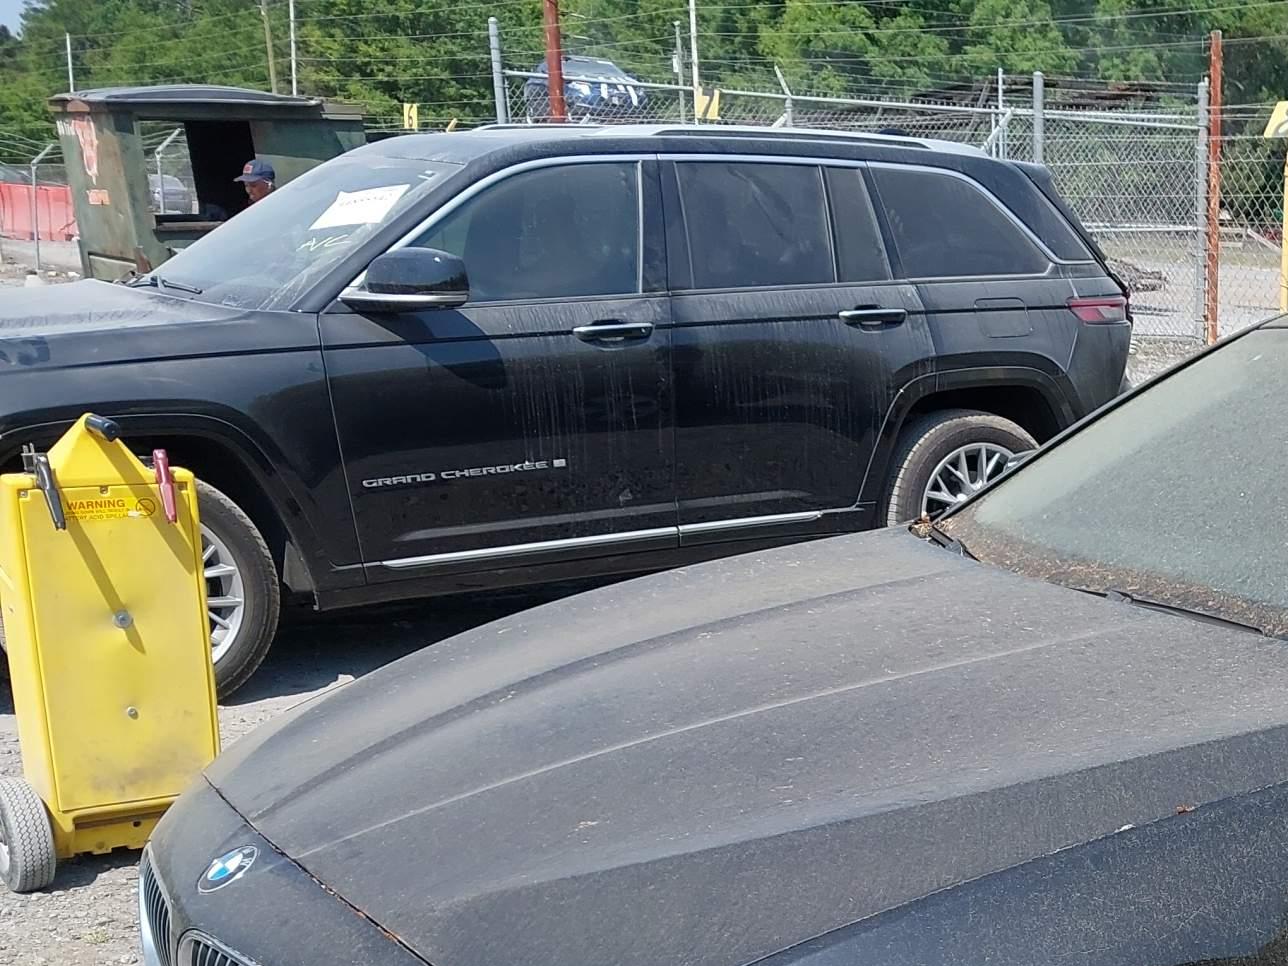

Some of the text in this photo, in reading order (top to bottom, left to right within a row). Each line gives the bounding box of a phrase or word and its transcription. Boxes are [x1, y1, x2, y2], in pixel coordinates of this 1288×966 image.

[408, 104, 413, 128] 6
[702, 87, 714, 119] 7
[362, 460, 549, 488] GRAND CHEROKEE
[66, 499, 126, 511] WARNING
